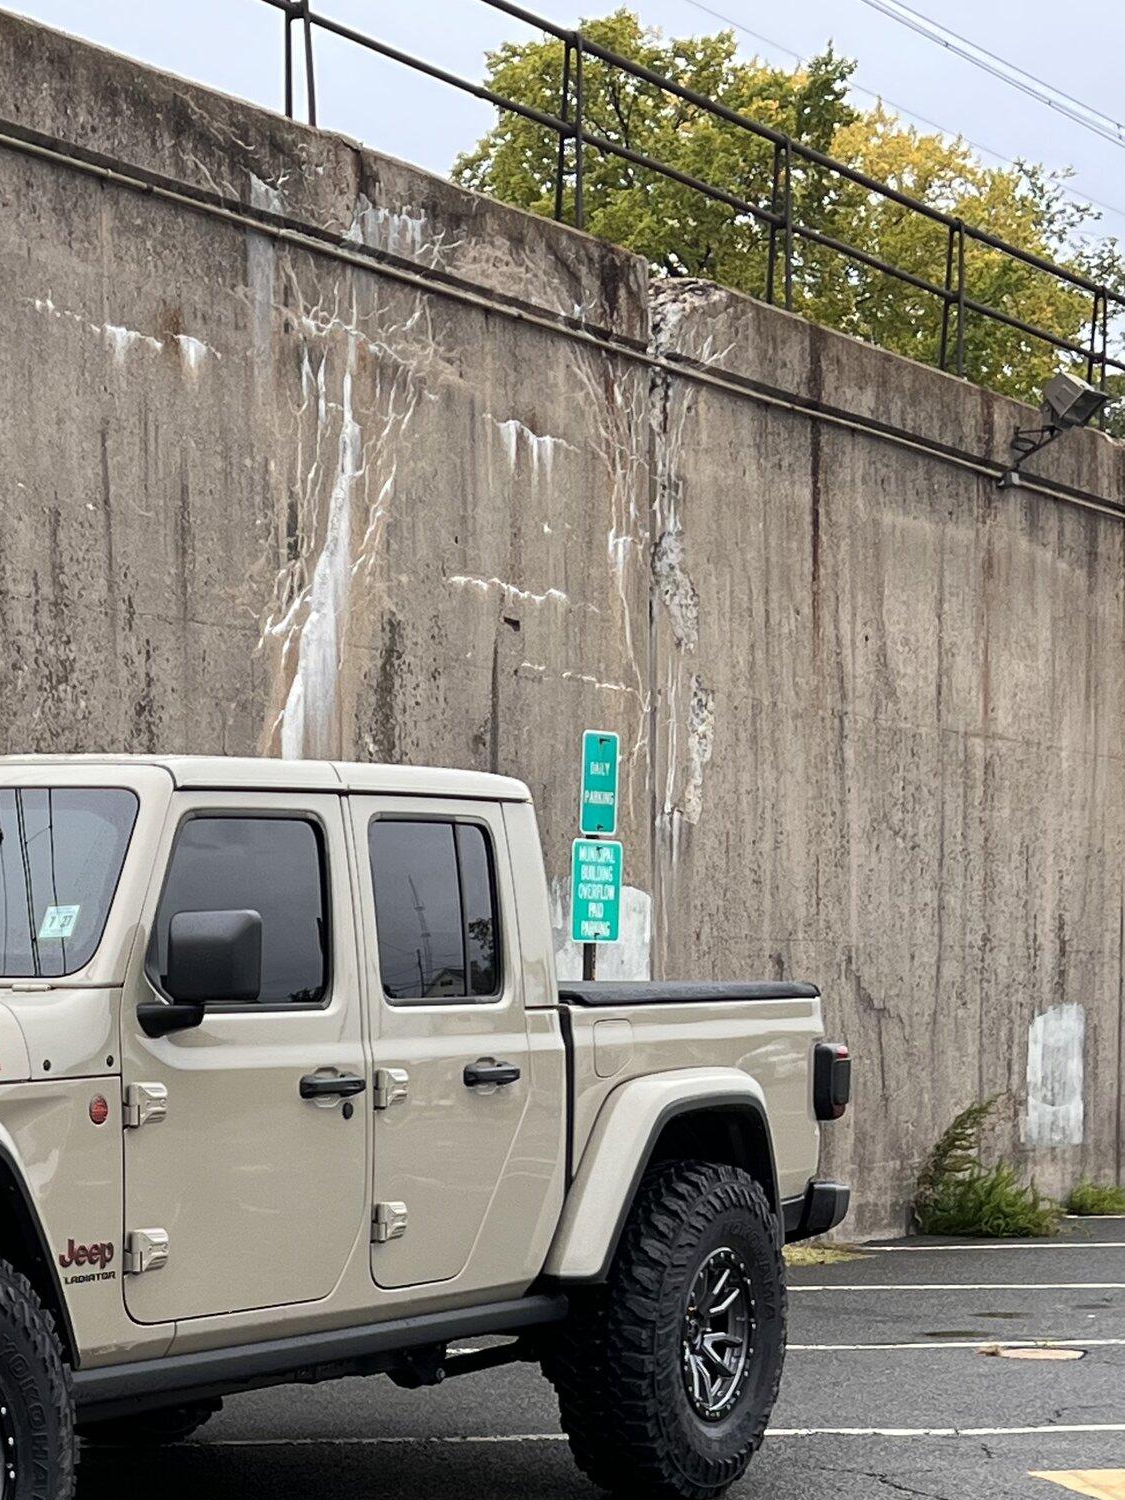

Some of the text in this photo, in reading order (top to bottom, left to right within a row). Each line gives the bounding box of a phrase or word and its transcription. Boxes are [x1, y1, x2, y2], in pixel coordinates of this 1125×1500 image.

[590, 761, 611, 776] DAILY
[584, 790, 614, 805] PARKING
[579, 845, 615, 863] MUNICIPAL
[581, 864, 614, 882] BUILDING
[578, 883, 615, 900] OVERFLOW
[588, 901, 604, 918] PAID
[581, 920, 610, 937] PARKING
[59, 1238, 114, 1269] Jeep
